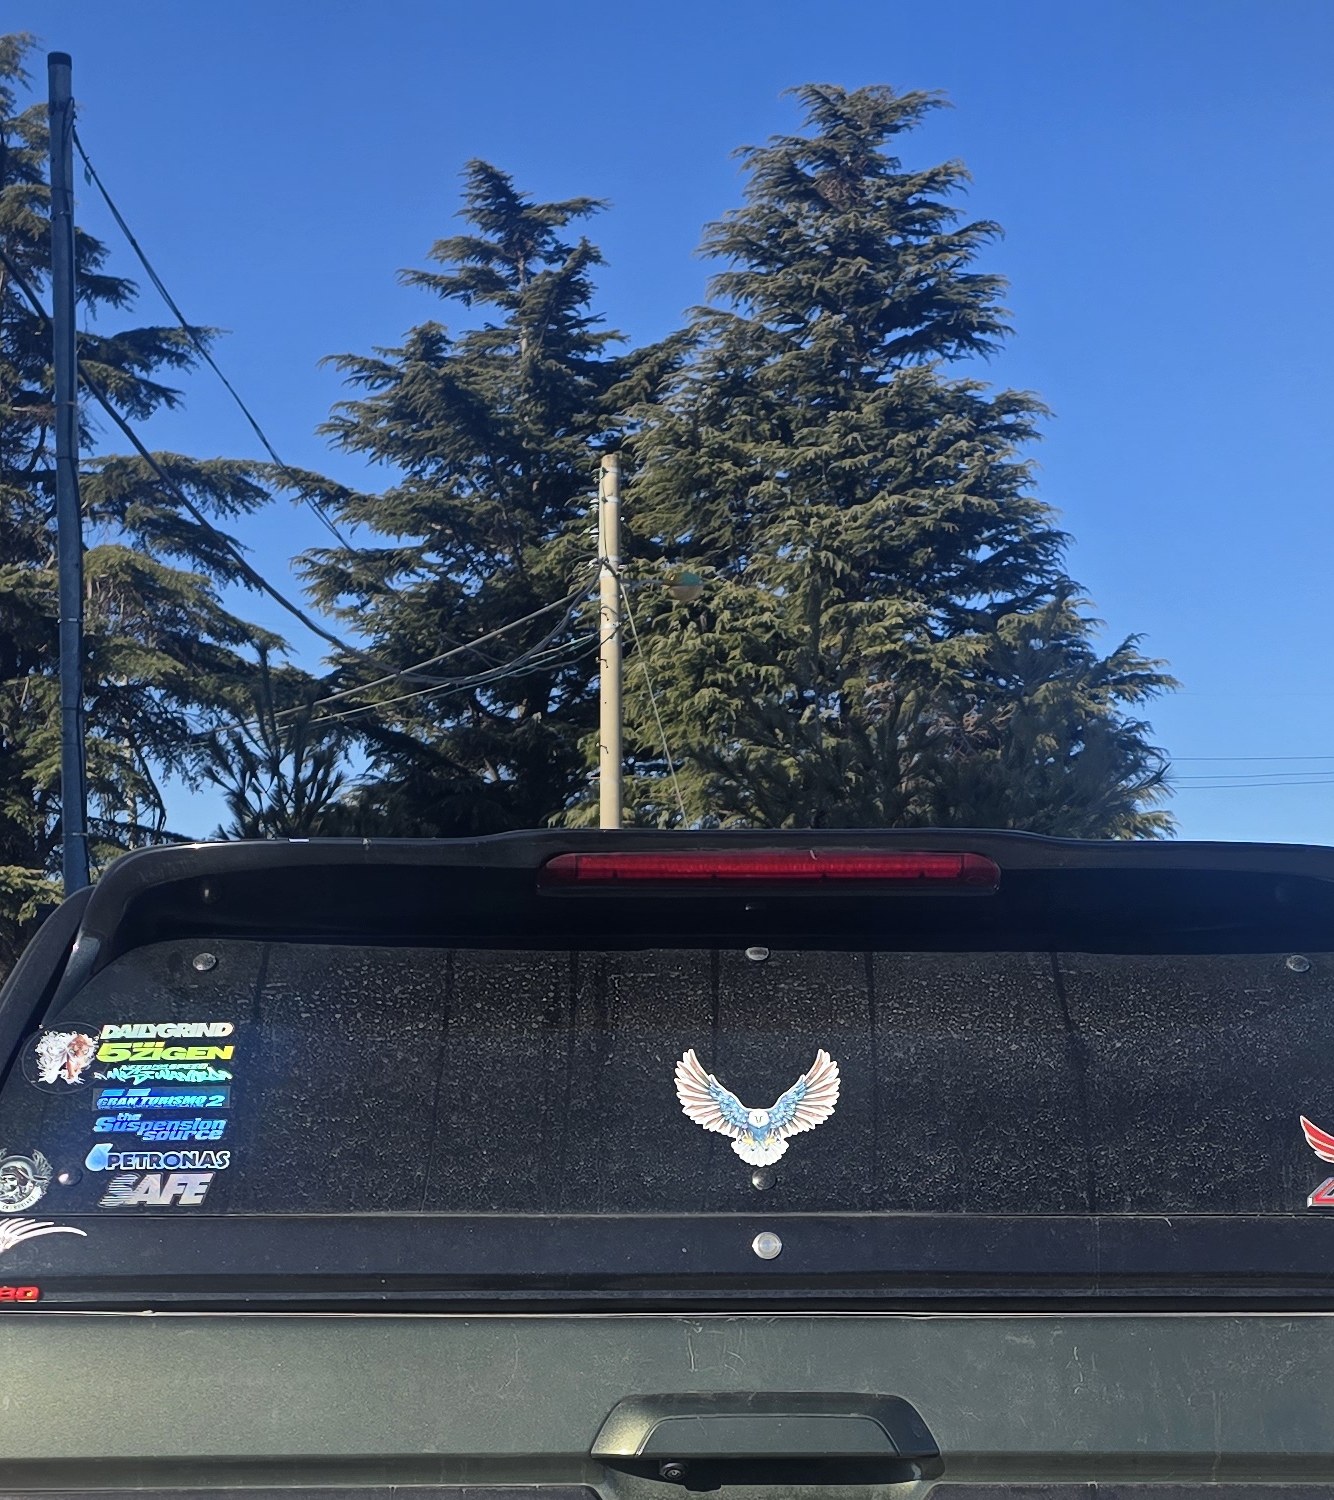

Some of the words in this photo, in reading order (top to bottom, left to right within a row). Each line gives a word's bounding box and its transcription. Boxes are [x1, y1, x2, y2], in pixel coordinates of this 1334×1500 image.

[99, 1022, 234, 1040] DAILYGRIND
[205, 1094, 226, 1107] 2
[93, 1116, 227, 1136] Suspension
[117, 1112, 142, 1122] the
[141, 1129, 224, 1141] source
[106, 1151, 230, 1170] PETRONAS
[98, 1173, 215, 1207] SAFE
